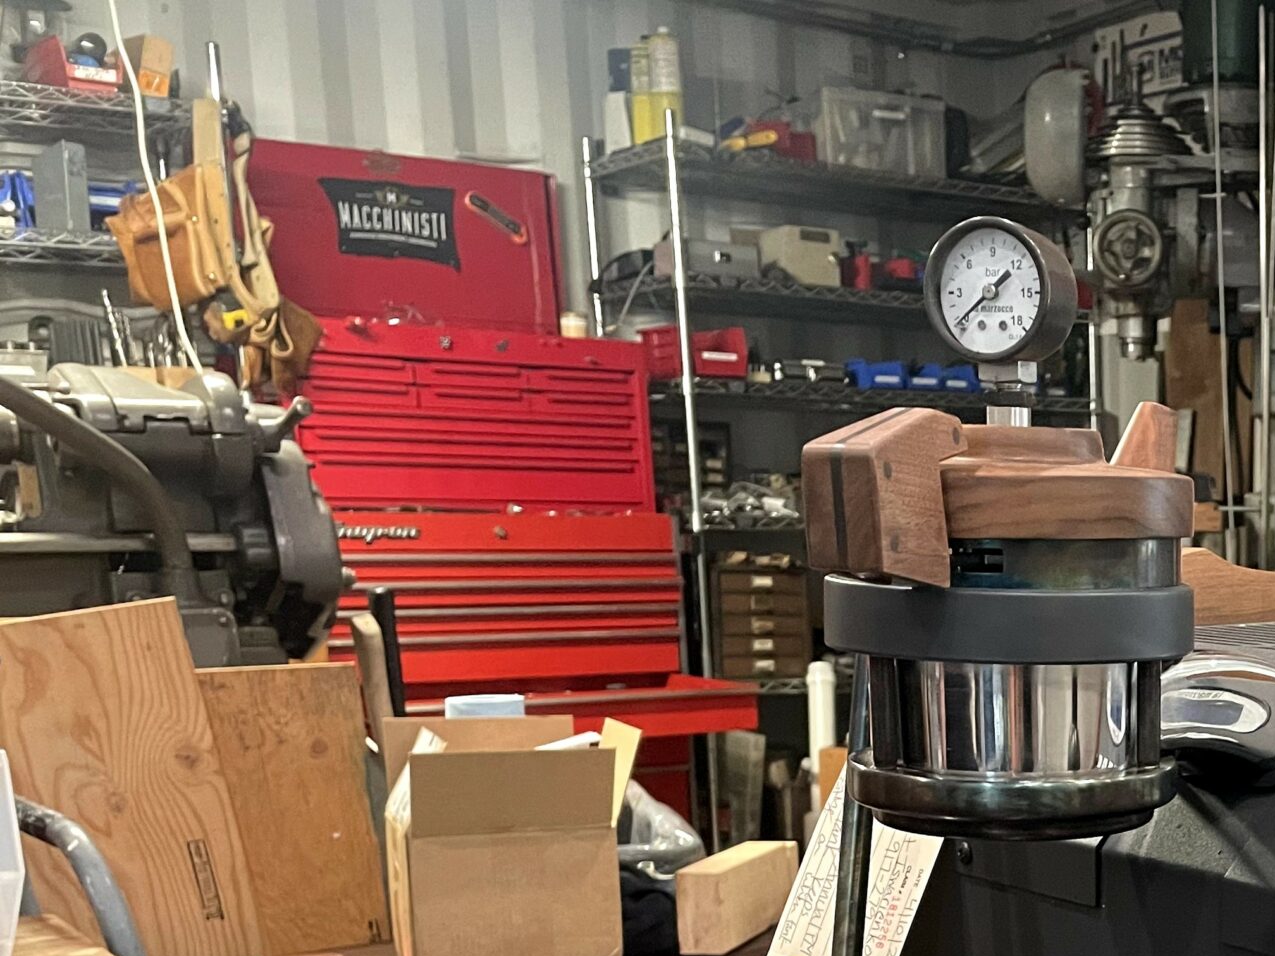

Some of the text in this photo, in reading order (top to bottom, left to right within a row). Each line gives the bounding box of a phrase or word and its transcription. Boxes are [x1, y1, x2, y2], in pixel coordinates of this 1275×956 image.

[338, 200, 447, 241] MACCHINISTI
[989, 246, 996, 258] 9
[966, 259, 973, 270] 6
[1010, 259, 1023, 270] 12
[985, 267, 1001, 277] bar
[956, 287, 963, 298] 3
[1021, 287, 1033, 298] 15
[980, 305, 1014, 313] marzocco
[1011, 315, 1023, 326] 18
